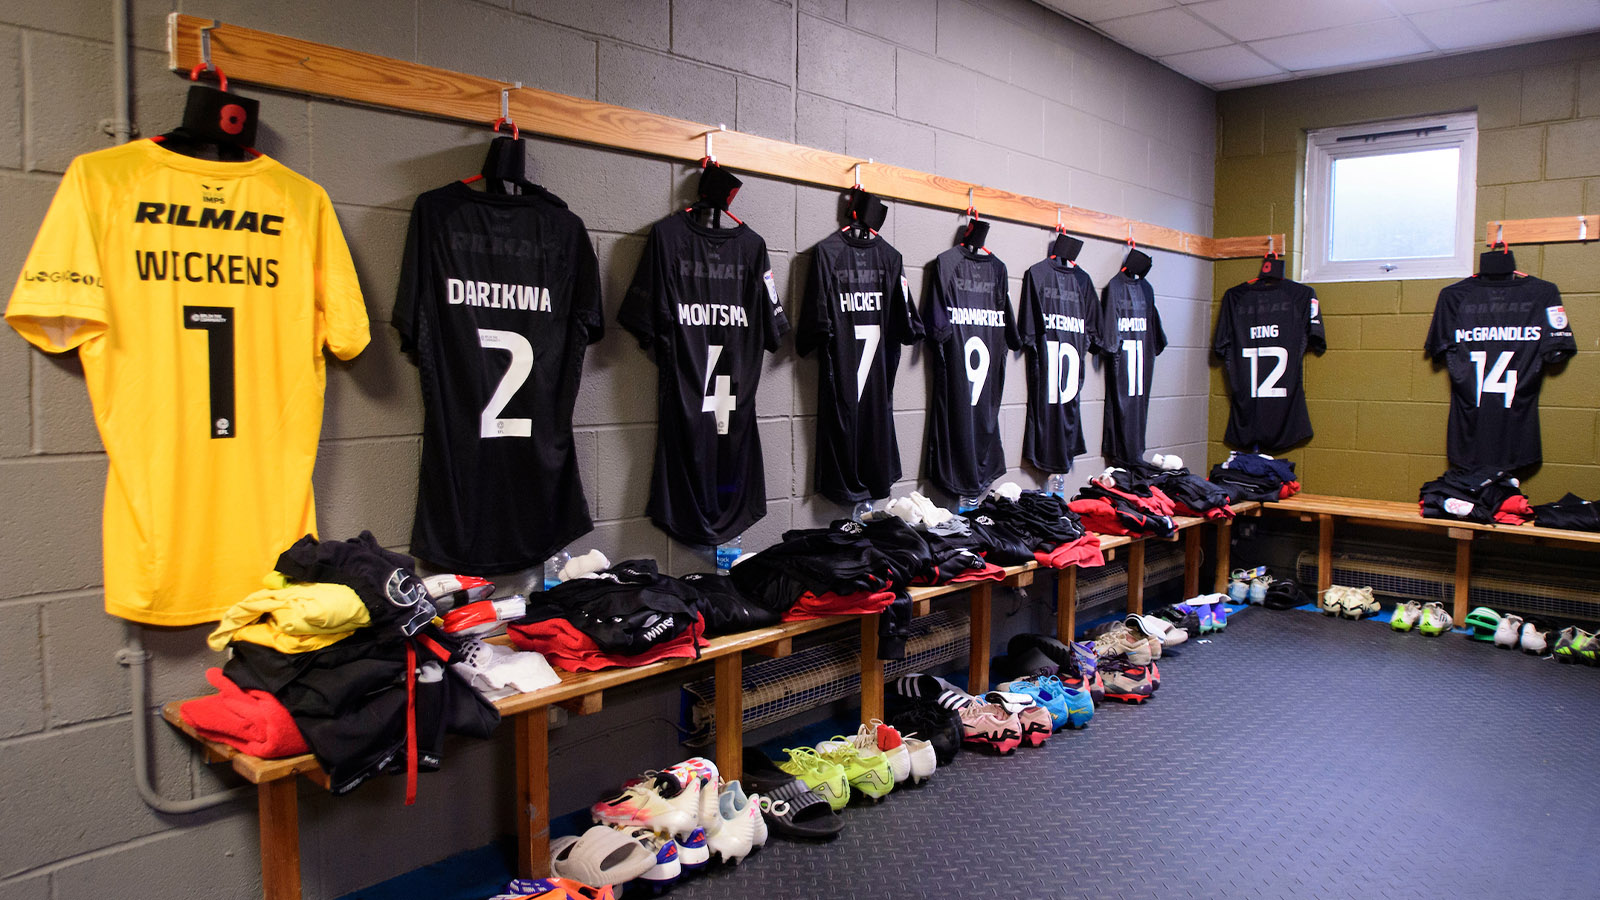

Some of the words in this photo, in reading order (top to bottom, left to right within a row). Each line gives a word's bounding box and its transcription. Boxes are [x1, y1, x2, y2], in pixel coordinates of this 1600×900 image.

[135, 201, 285, 236] RILMAC
[135, 249, 279, 288] WICKENS
[446, 277, 552, 313] DARIKWA
[677, 303, 749, 328] MONTSMA
[1042, 313, 1086, 334] CKERMAN
[1249, 324, 1280, 340] RING
[1455, 326, 1542, 344] McGRANDLES
[183, 305, 236, 439] 1
[477, 328, 534, 439] 2
[701, 344, 737, 436] 4
[854, 324, 881, 403] 7
[964, 336, 991, 407] 9
[1045, 340, 1081, 406] 10
[1121, 339, 1144, 398] 11
[1241, 346, 1289, 399] 12
[1470, 350, 1518, 409] 14
